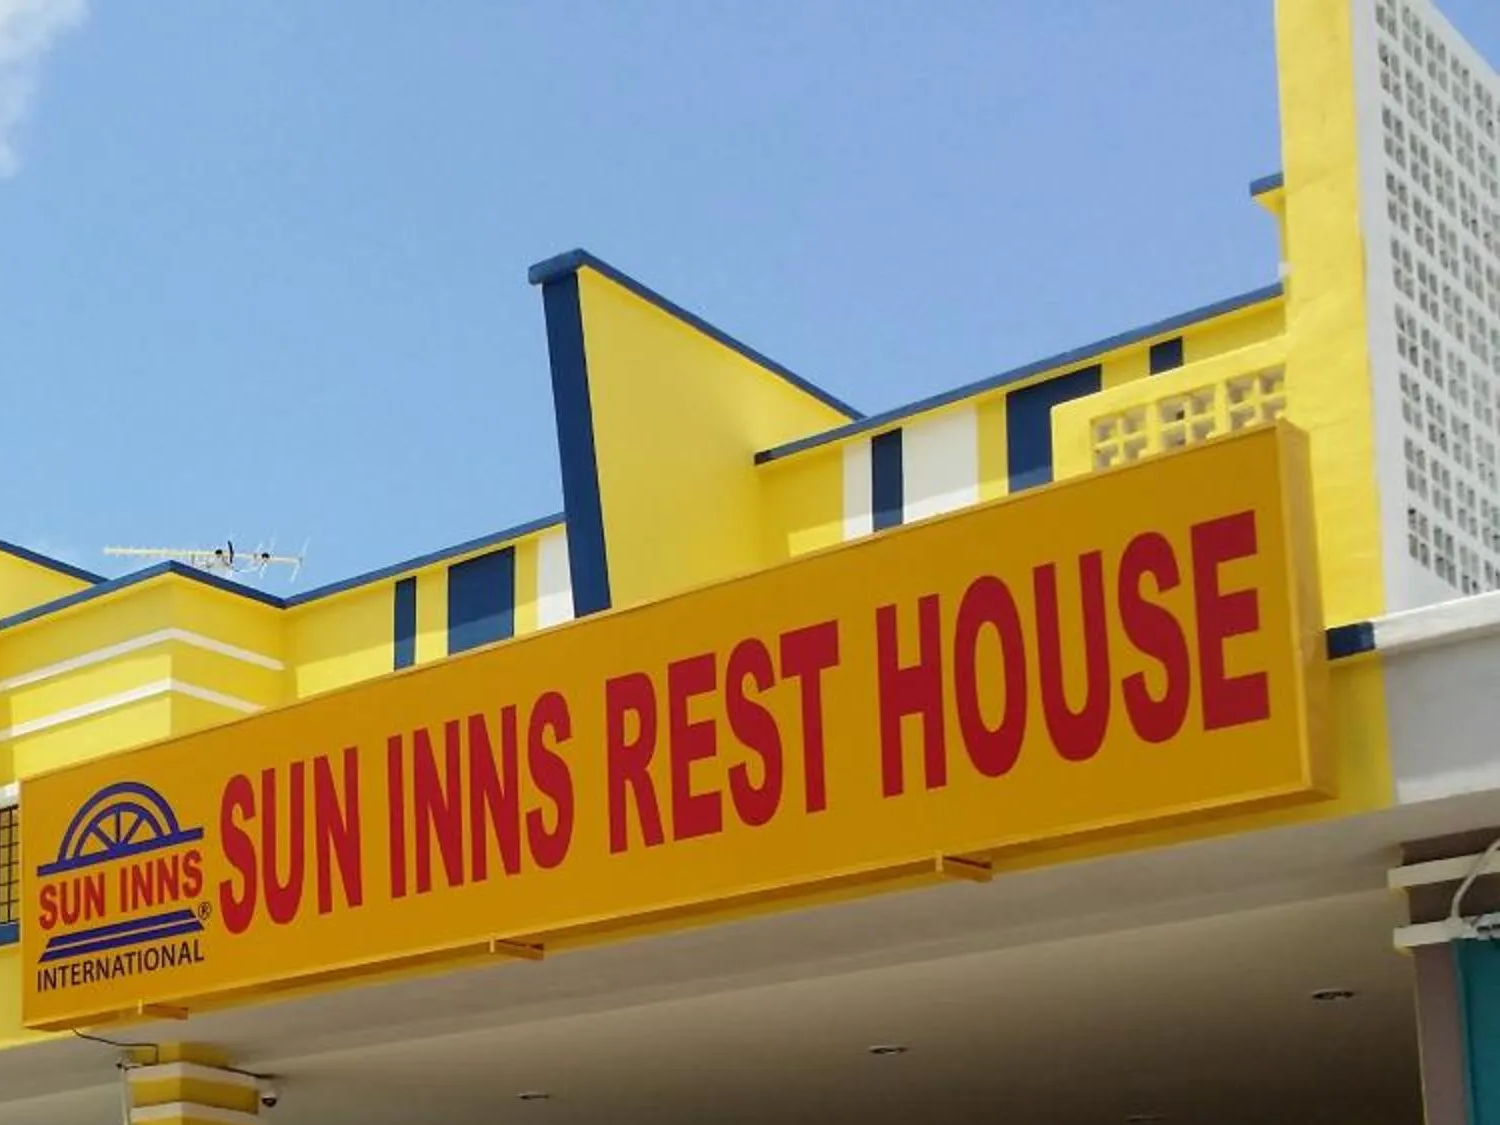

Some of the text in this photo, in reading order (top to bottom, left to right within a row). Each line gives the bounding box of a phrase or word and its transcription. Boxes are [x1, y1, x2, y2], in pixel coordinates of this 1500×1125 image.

[218, 509, 1271, 935] SUN INNS REST HOUSE
[38, 850, 203, 931] SUN INNS
[37, 938, 205, 993] INTERNATIONAL
